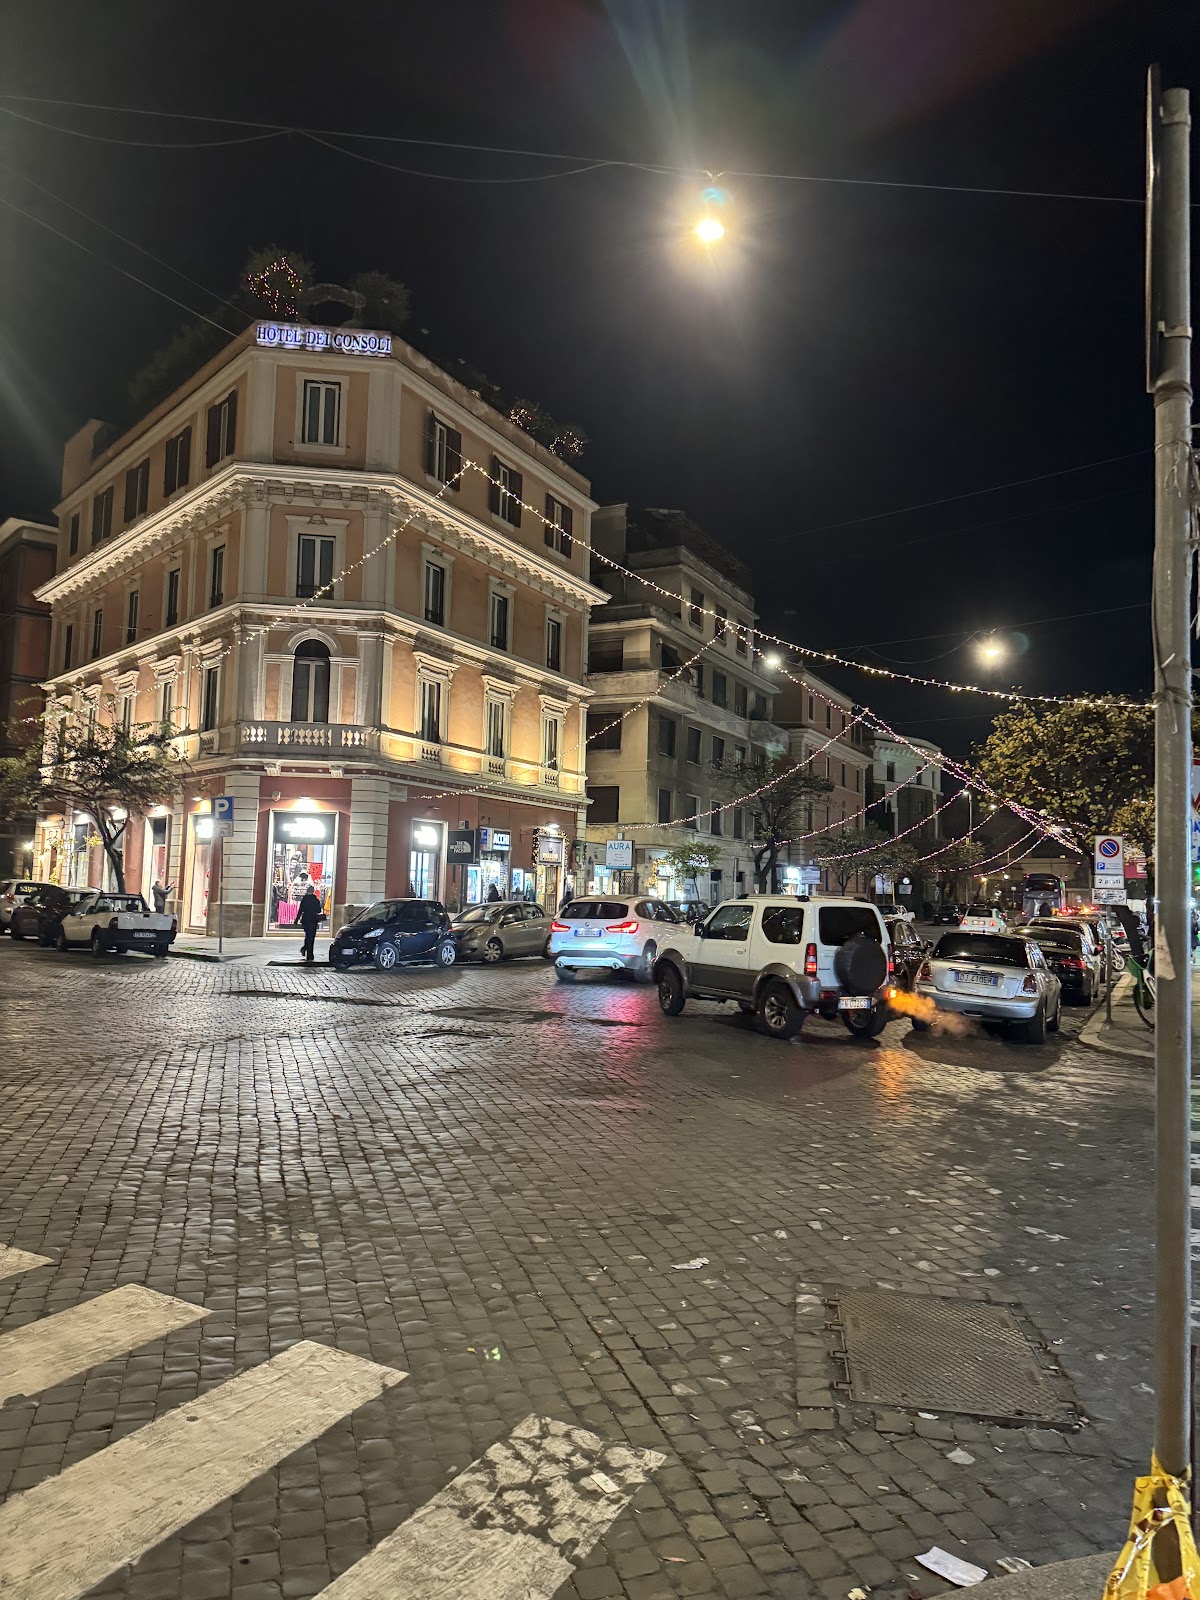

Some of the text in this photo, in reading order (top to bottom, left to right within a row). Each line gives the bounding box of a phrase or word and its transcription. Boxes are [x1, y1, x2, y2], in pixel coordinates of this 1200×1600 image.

[257, 326, 391, 351] HOTEL DEI CONSOLI
[214, 799, 229, 818] P
